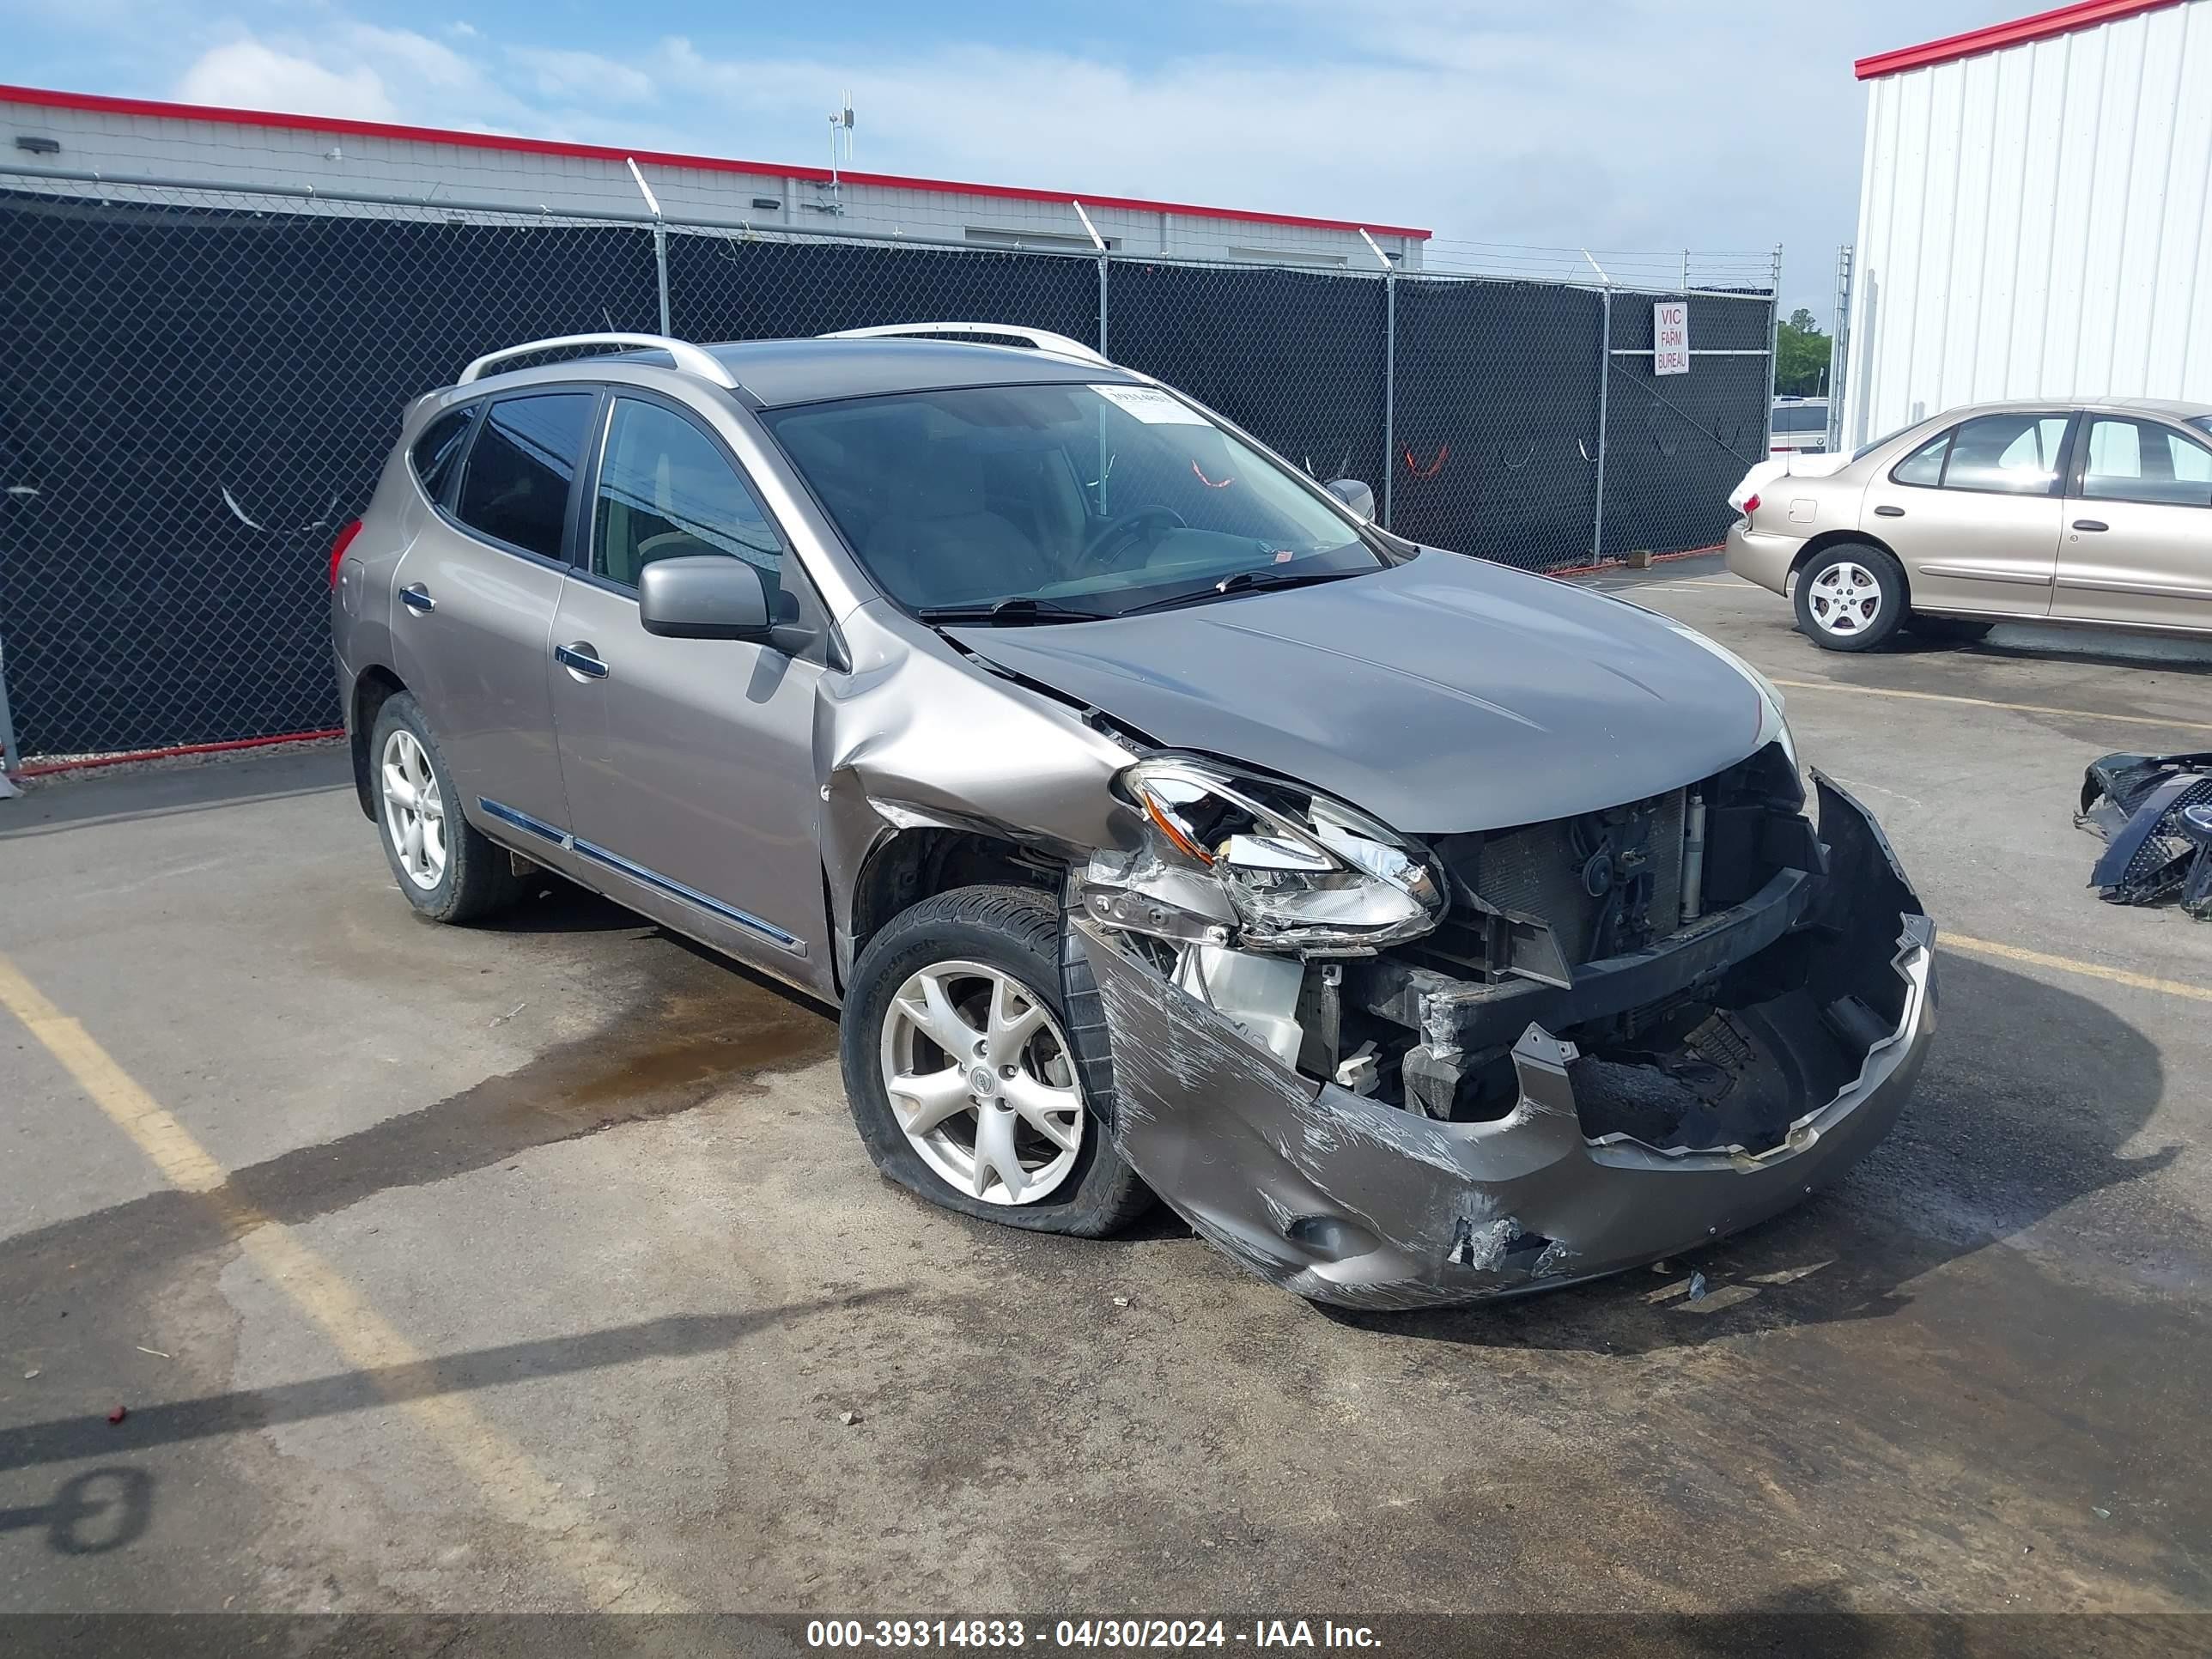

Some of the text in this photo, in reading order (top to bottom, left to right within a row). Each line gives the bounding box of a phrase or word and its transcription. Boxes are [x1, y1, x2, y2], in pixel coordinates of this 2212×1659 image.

[1661, 309, 1681, 325] VIC
[1661, 331, 1682, 347] FARM
[1658, 352, 1686, 369] BUREAU
